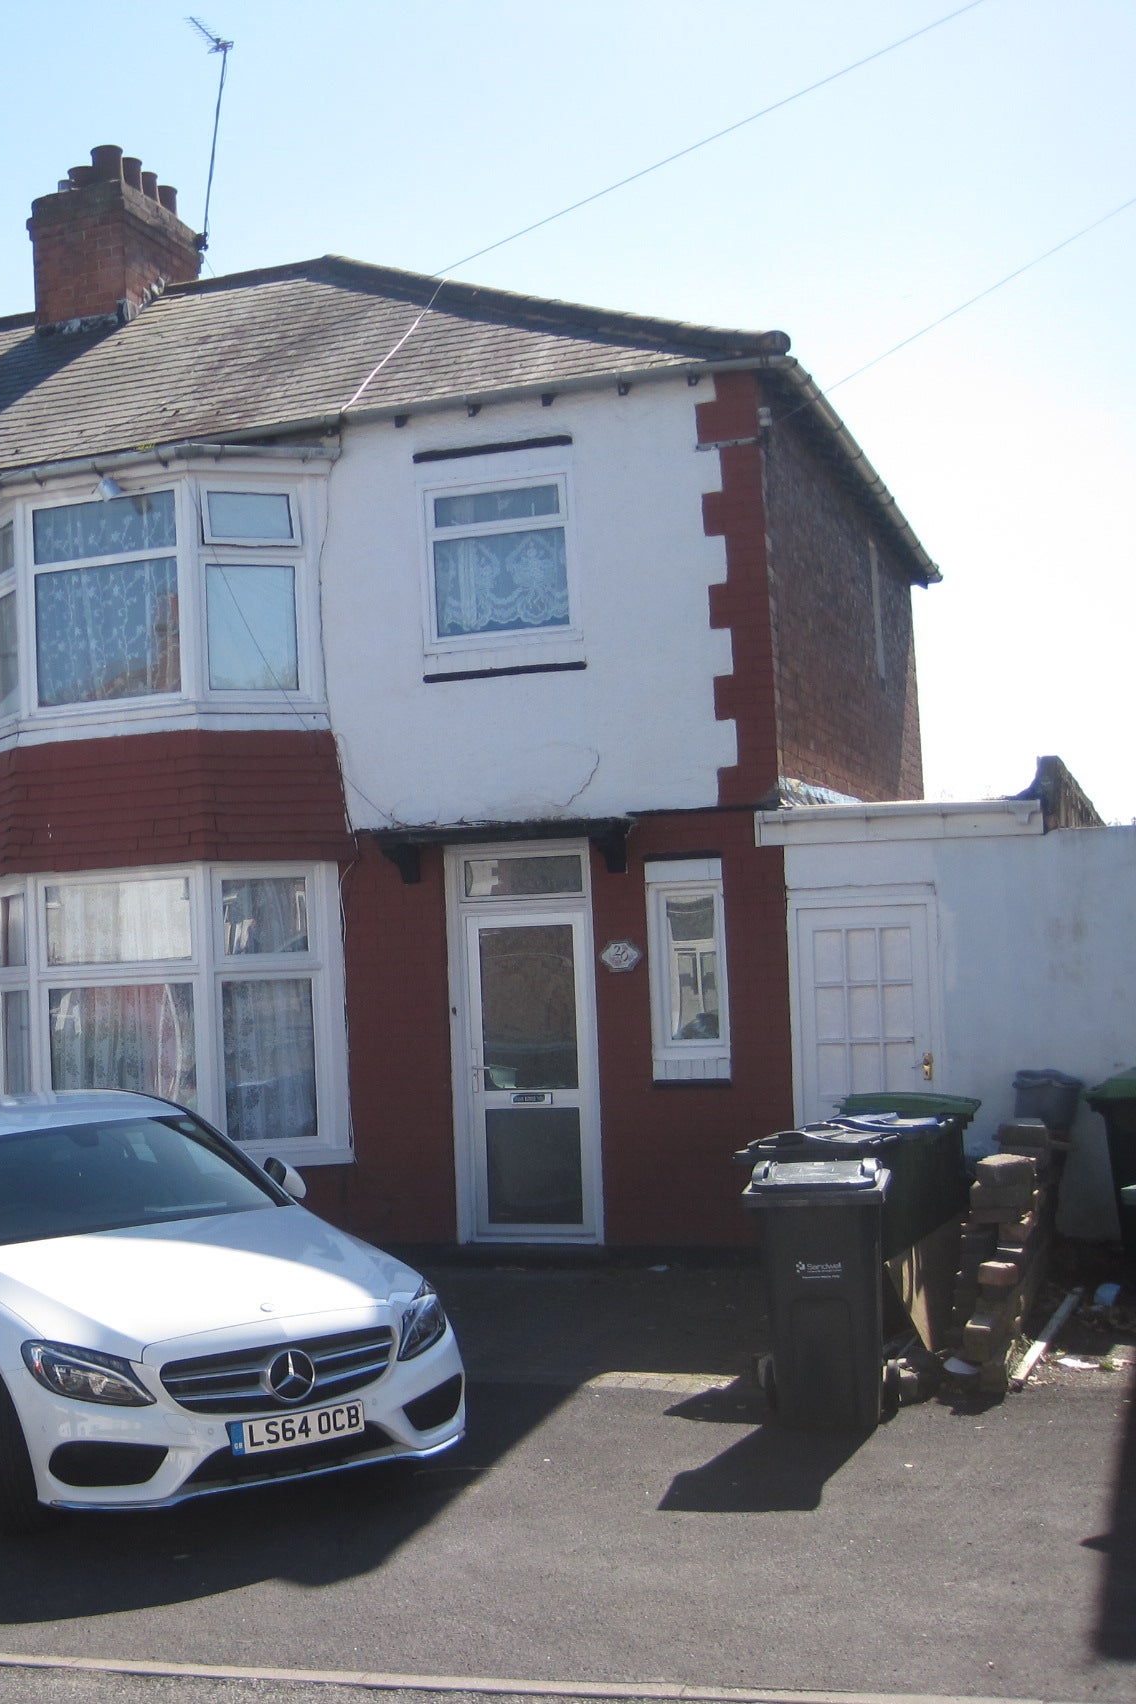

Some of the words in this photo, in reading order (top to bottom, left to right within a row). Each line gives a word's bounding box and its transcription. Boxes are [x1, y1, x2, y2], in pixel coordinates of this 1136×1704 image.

[806, 1261, 842, 1270] Sandwell
[248, 1416, 311, 1448] LS64
[317, 1404, 360, 1435] OCB
